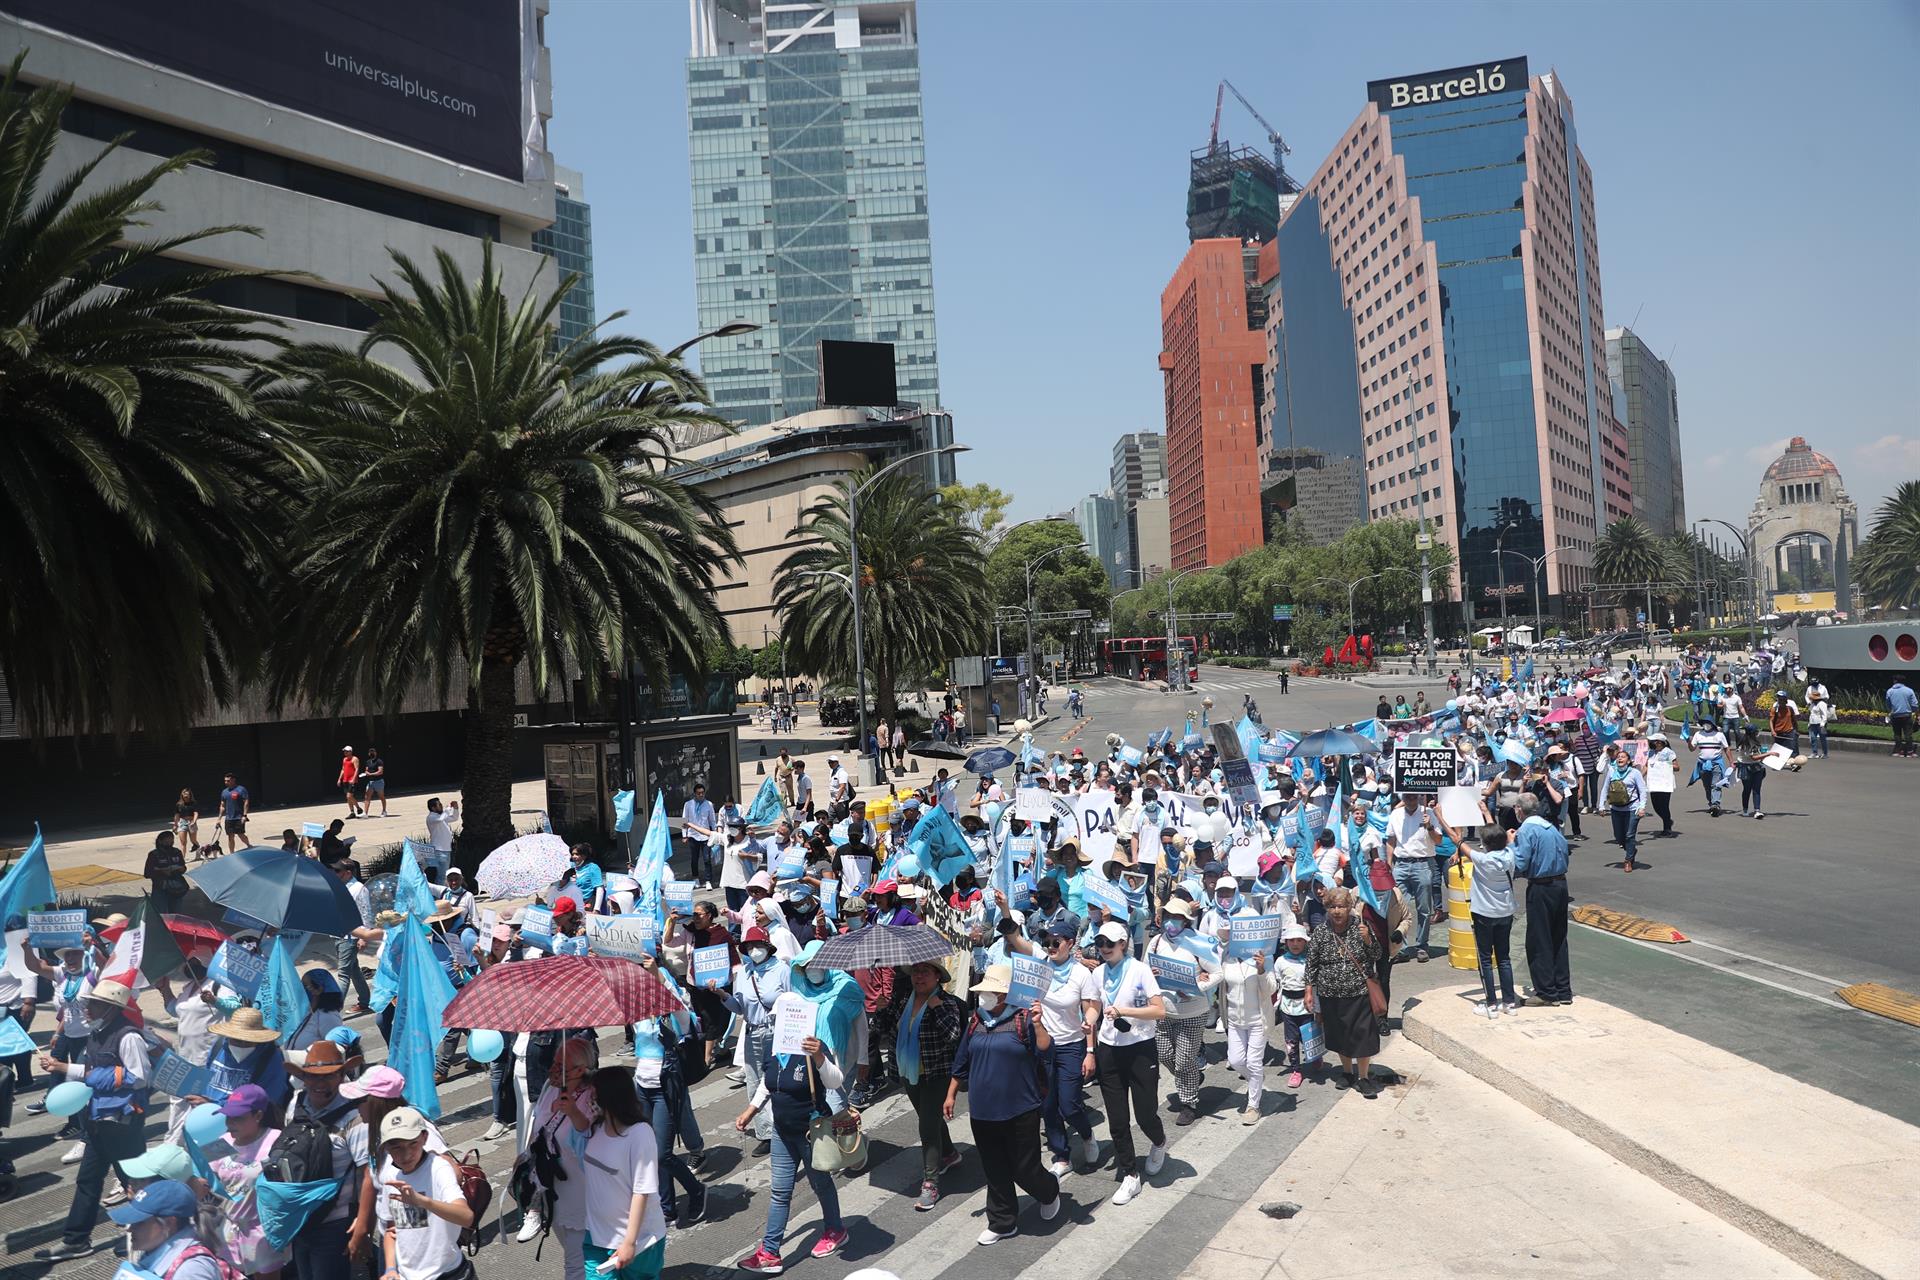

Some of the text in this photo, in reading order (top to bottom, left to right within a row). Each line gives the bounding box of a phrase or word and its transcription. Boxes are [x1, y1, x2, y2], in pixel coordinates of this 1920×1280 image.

[324, 51, 477, 118] universalplus.com
[1389, 64, 1506, 108] Barceló
[1399, 751, 1452, 760] REZA POR
[1432, 760, 1453, 768] DEL
[1403, 768, 1448, 776] ABORTO
[40, 914, 82, 923] ABORTO
[1234, 919, 1278, 930] EL ABORTO
[590, 925, 608, 942] 40
[1258, 930, 1279, 939] SALUD
[696, 949, 728, 962] EL ABORTO
[222, 958, 254, 982] LATIR
[714, 960, 728, 968] SALUD
[1016, 959, 1026, 970] EL
[1162, 960, 1192, 975] ABORTO
[1014, 972, 1025, 982] NO
[1027, 975, 1036, 986] ES
[1164, 970, 1172, 978] ES
[1172, 973, 1195, 984] SALUD
